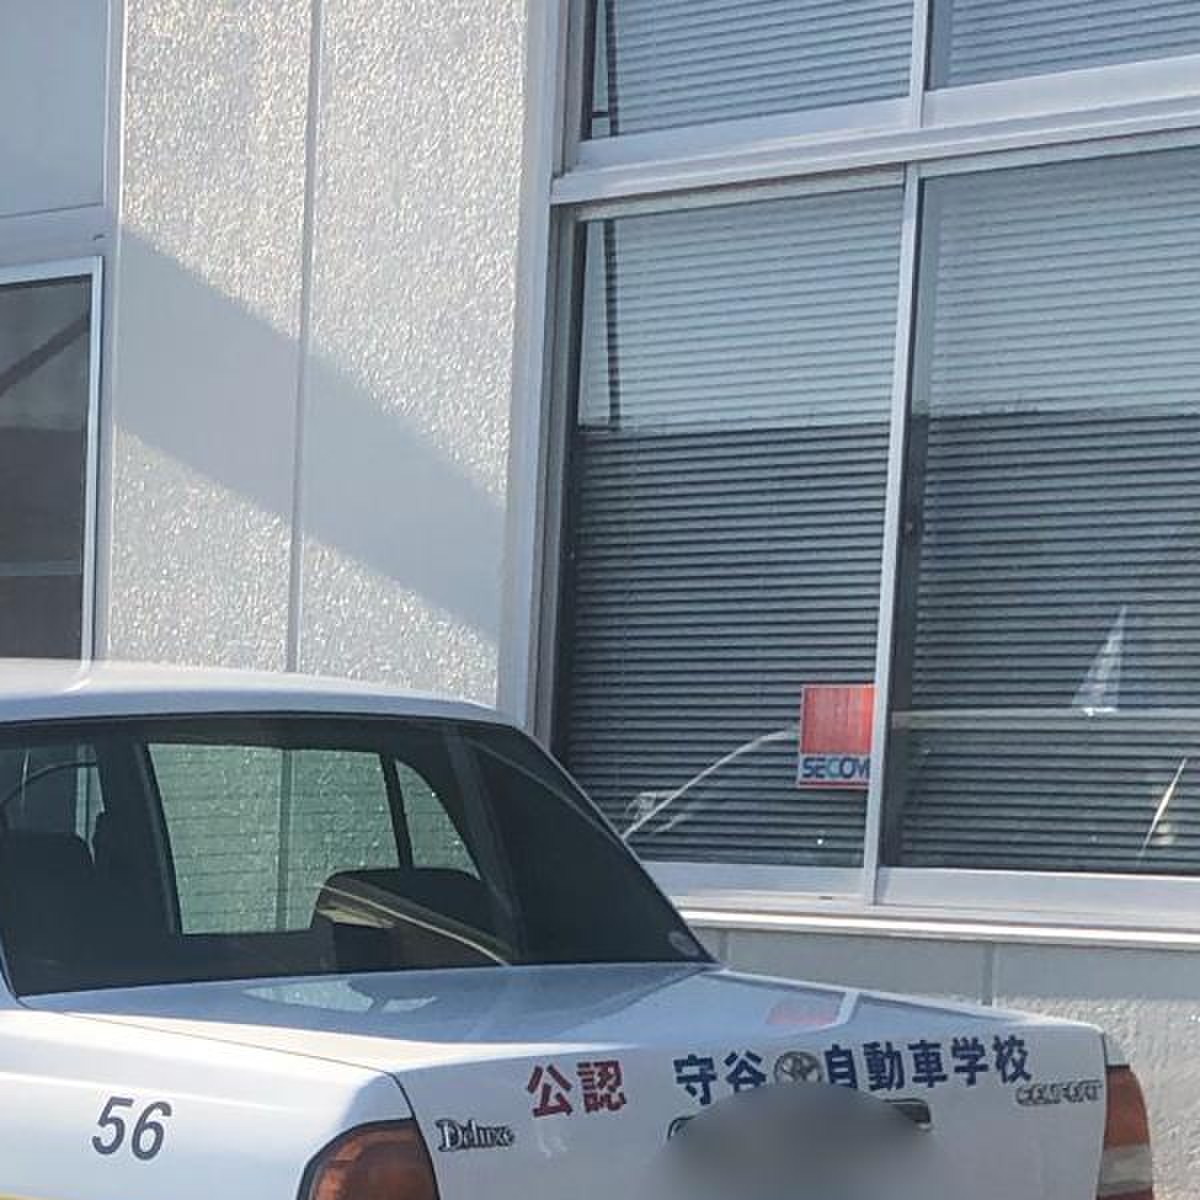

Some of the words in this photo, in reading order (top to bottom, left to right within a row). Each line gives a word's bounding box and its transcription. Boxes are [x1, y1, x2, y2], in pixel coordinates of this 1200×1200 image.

[528, 1060, 627, 1117] 公認
[673, 1051, 767, 1106] 守谷
[824, 1035, 1032, 1091] 自動車学校
[92, 1096, 172, 1160] 56
